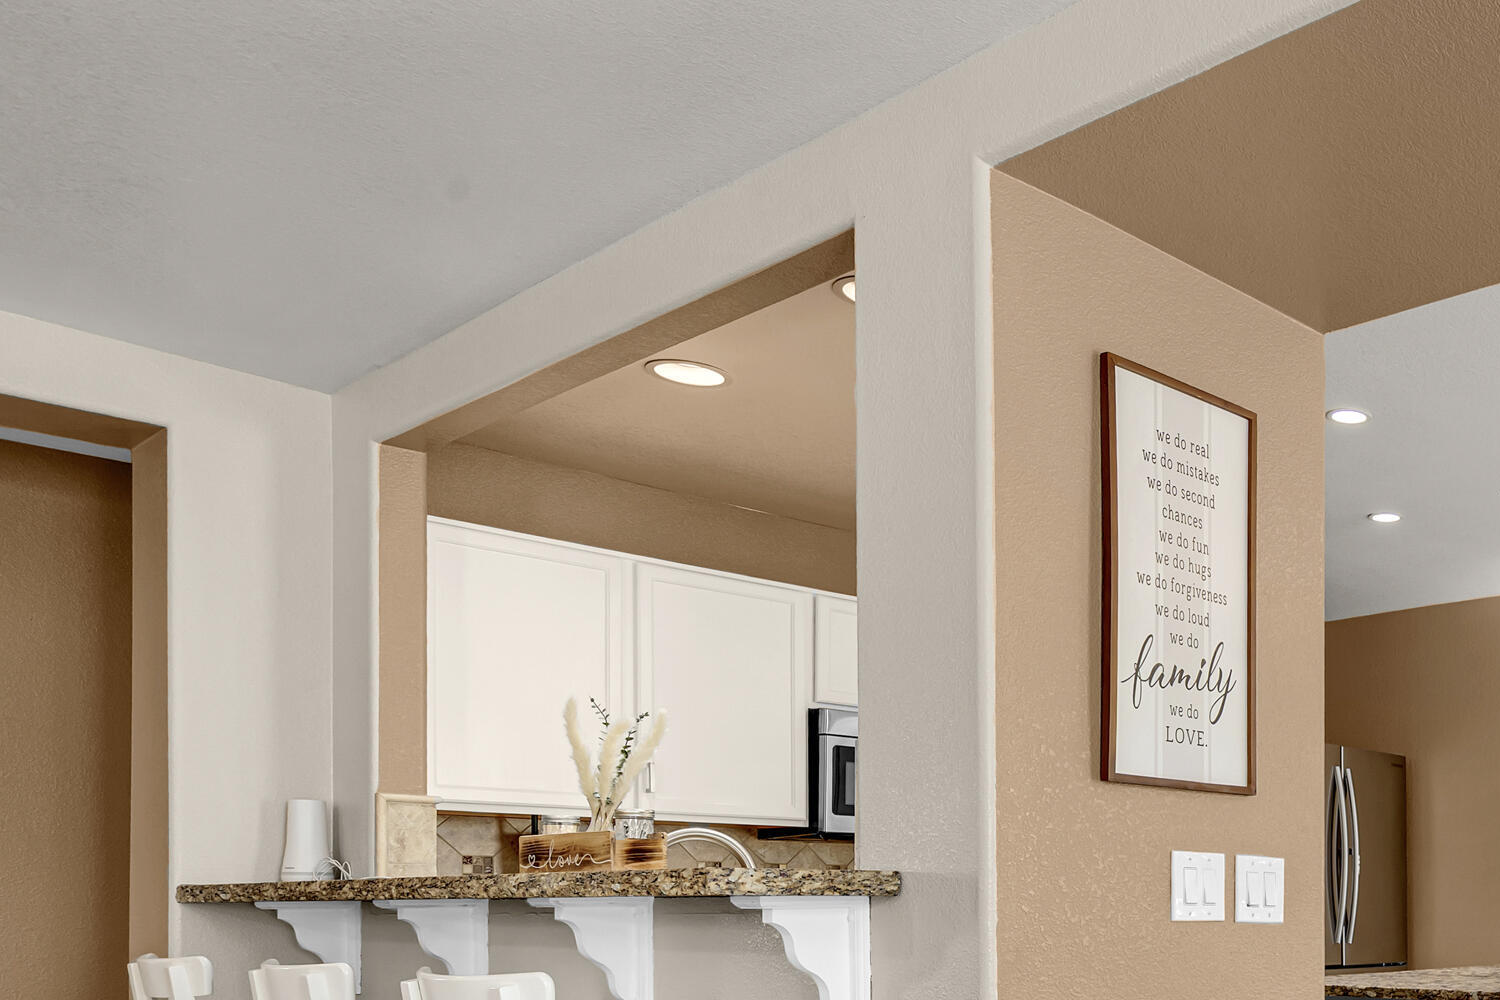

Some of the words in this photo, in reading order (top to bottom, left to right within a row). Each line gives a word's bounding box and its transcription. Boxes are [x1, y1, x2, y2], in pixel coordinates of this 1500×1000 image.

[1156, 429, 1171, 444] we
[1174, 433, 1187, 450] do
[1190, 442, 1210, 459] real
[1142, 449, 1157, 464] we
[1160, 452, 1173, 470] do
[1176, 461, 1220, 487] mistakes
[1146, 476, 1162, 492] we
[1165, 480, 1178, 497] do
[1180, 487, 1216, 510] second
[1162, 504, 1203, 530] chances
[1159, 530, 1173, 545] we
[1176, 532, 1189, 549] do
[1192, 536, 1209, 556] fun
[1155, 551, 1169, 566] we
[1172, 553, 1185, 570] do
[1188, 557, 1212, 581] hugs
[1136, 571, 1151, 586] we
[1154, 573, 1168, 590] do
[1170, 577, 1228, 606] forgiveness
[1155, 604, 1169, 618] we
[1172, 605, 1185, 622] do
[1188, 608, 1210, 628] loud
[1169, 632, 1184, 646] we
[1186, 633, 1199, 649] do
[1121, 634, 1237, 725] family
[1169, 704, 1184, 718] we
[1186, 703, 1199, 720] do
[1165, 725, 1208, 747] LOVE.
[540, 839, 592, 869] love
